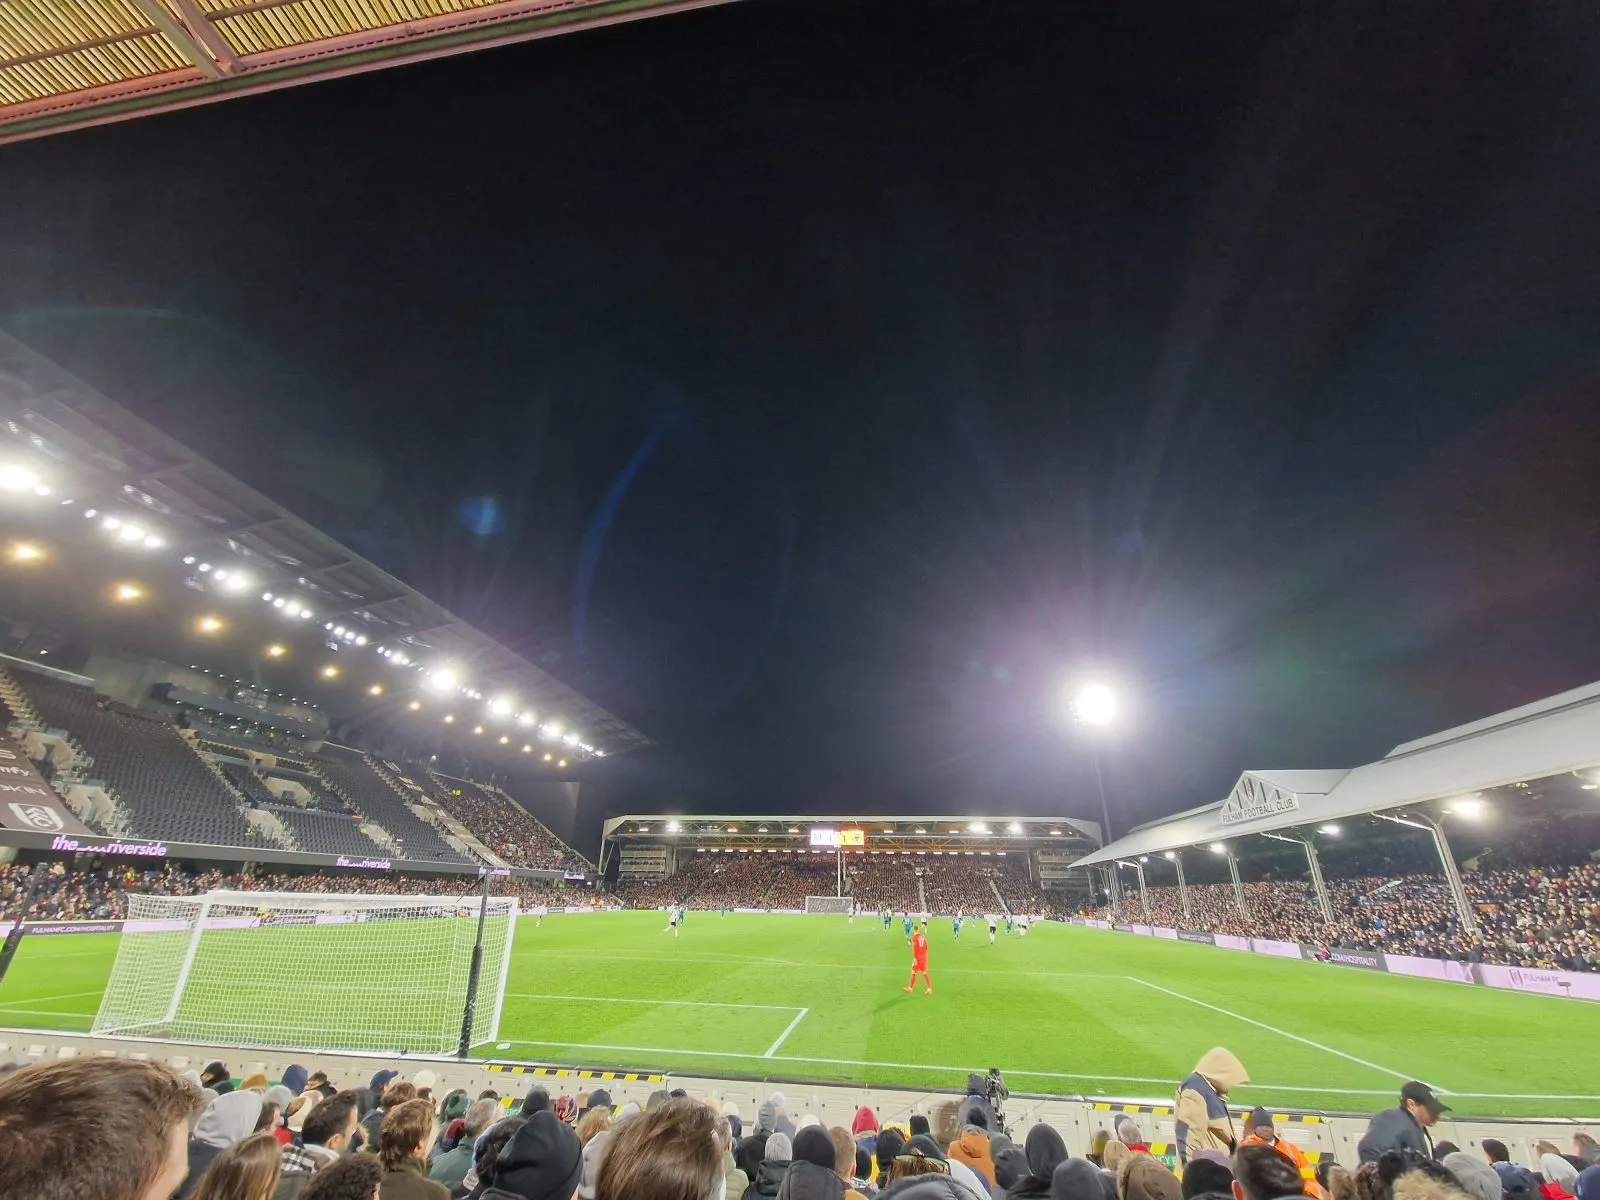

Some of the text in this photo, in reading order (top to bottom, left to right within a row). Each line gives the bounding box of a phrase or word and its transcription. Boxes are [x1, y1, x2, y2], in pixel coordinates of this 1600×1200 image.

[1222, 798, 1294, 823] FULHAM FOOTBALL CLUB
[51, 834, 167, 857] the riverside
